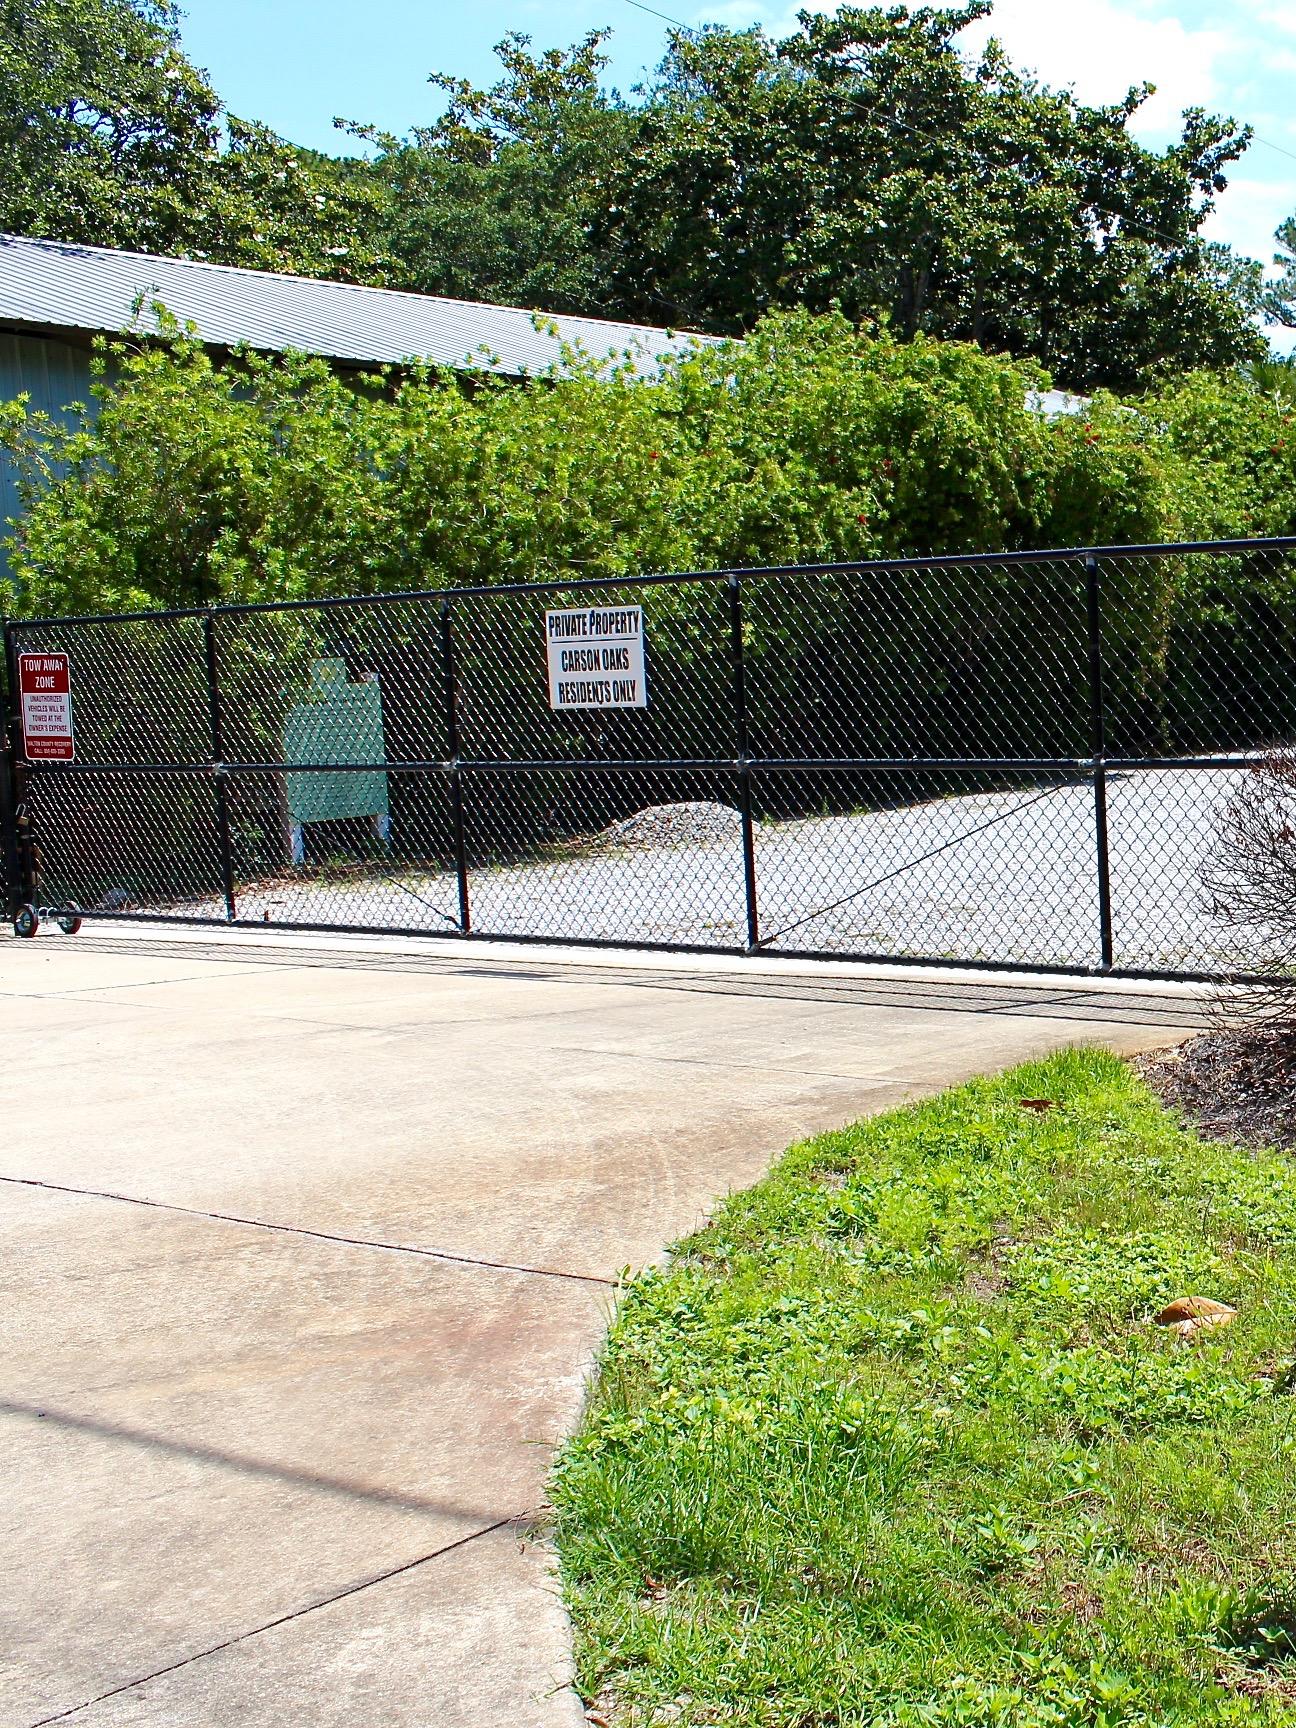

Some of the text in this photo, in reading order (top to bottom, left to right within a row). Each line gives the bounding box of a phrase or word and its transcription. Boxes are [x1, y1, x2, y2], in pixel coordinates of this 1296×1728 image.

[548, 610, 639, 637] PRIVATE PROPERTY
[23, 658, 64, 671] TOW AWAY
[561, 647, 630, 673] CARSON OAKS
[35, 676, 56, 688] ZONE
[558, 679, 637, 704] RESIDENTS ONLY
[48, 705, 59, 713] WILL
[60, 705, 66, 713] BE
[32, 714, 47, 722] TOWED
[49, 724, 67, 732] EXPENSE
